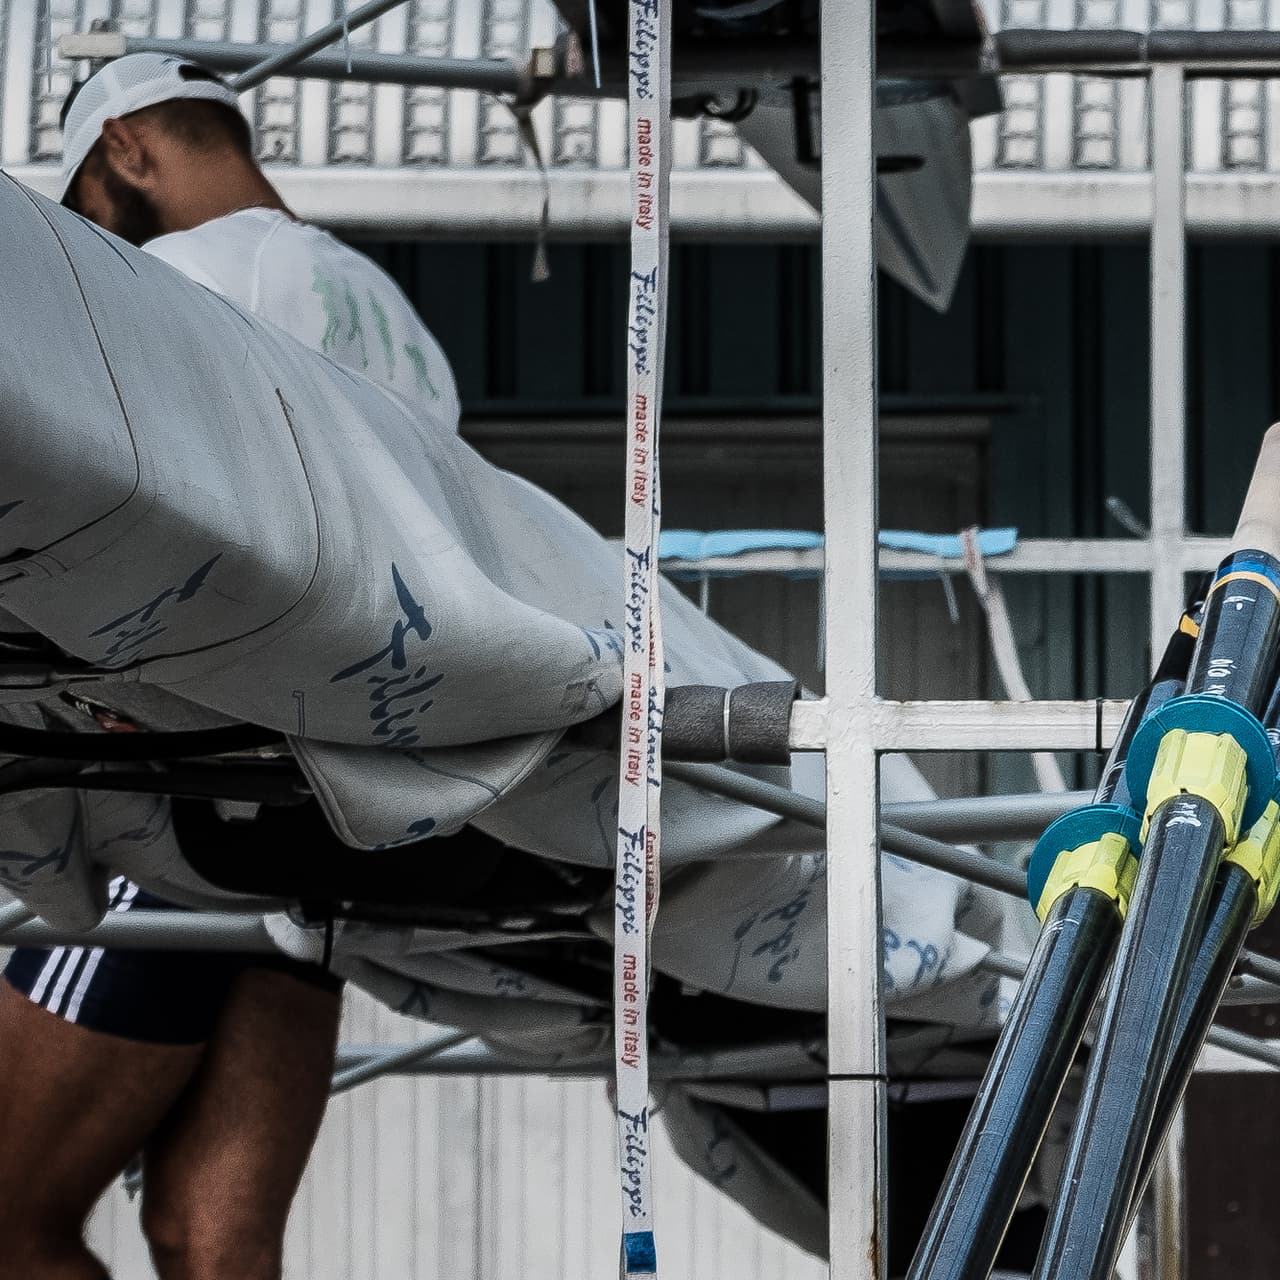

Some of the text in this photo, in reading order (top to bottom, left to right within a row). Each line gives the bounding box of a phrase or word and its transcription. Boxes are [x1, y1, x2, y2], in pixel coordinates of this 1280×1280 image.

[637, 117, 653, 229] made in italy
[630, 266, 657, 376] Filippi
[632, 394, 648, 507] made in italy
[626, 546, 651, 653] Filippi
[625, 672, 642, 786] made in italy
[617, 825, 644, 934] Filippi
[621, 954, 637, 1068] made in italy
[618, 1105, 648, 1218] Filippi
